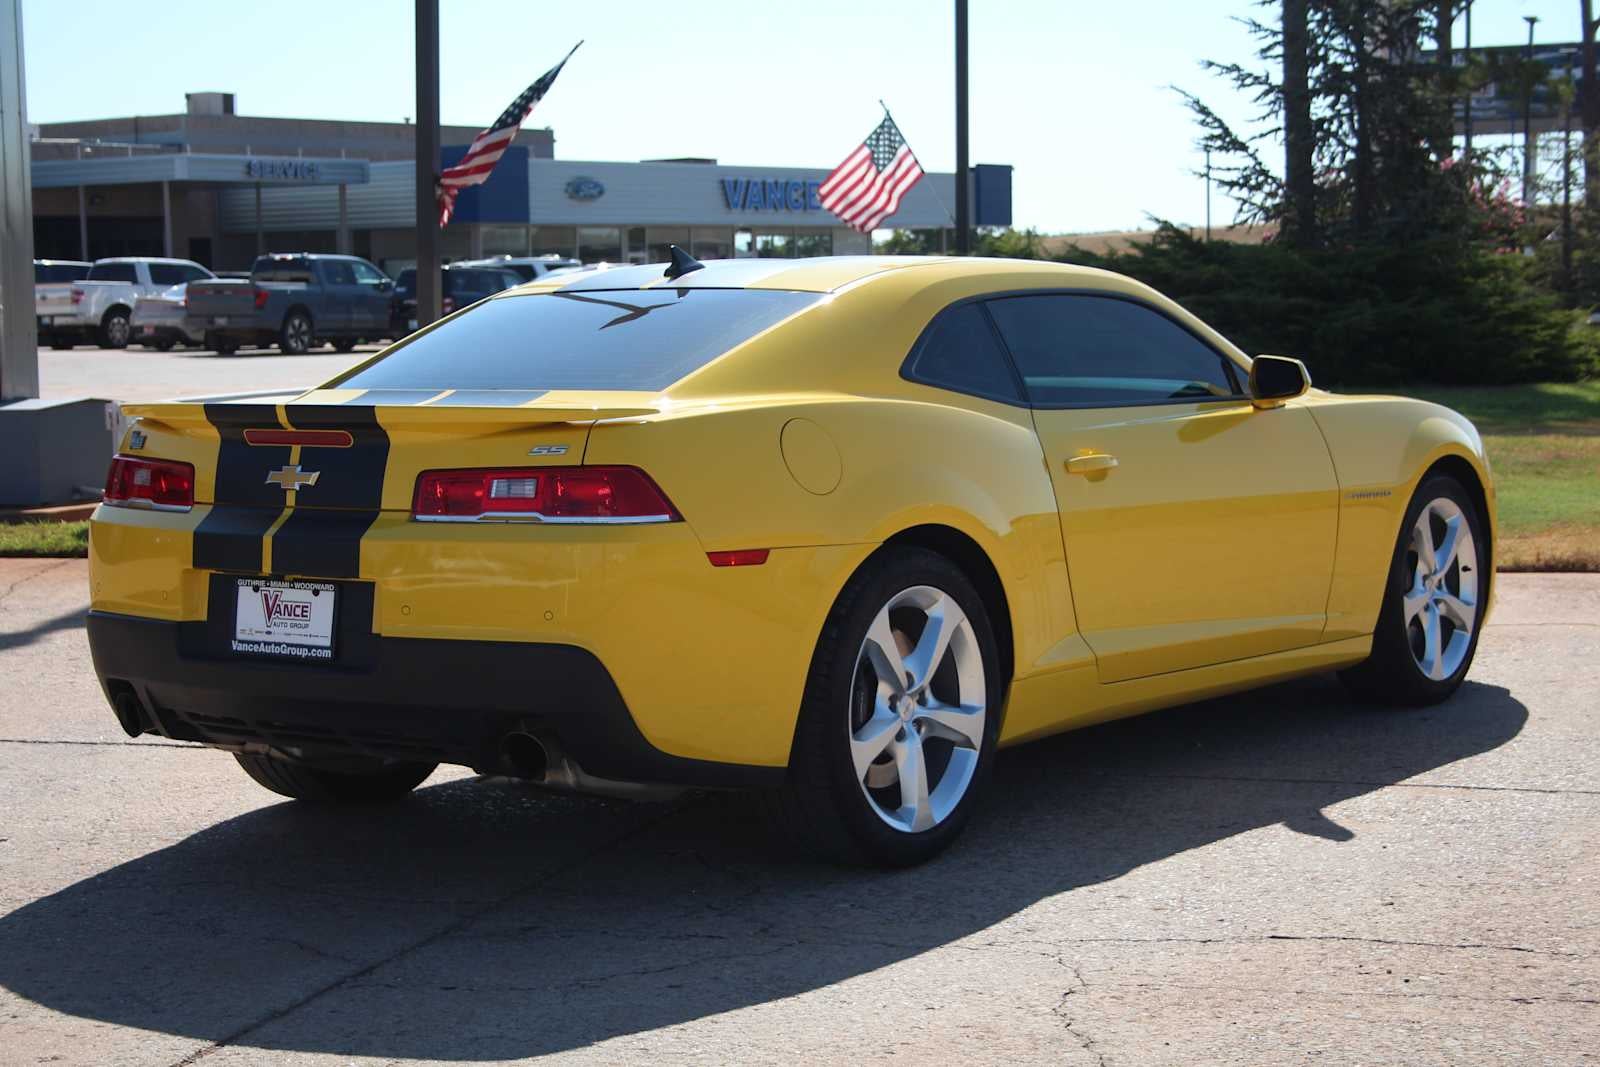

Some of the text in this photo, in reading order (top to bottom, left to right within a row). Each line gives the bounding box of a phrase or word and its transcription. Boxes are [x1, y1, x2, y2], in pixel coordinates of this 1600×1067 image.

[721, 177, 820, 211] VANCE
[528, 445, 569, 456] SS
[237, 579, 335, 591] GUTHRIE MIAMI WOODWARD
[231, 640, 332, 658] VanceAutoGroup.com
